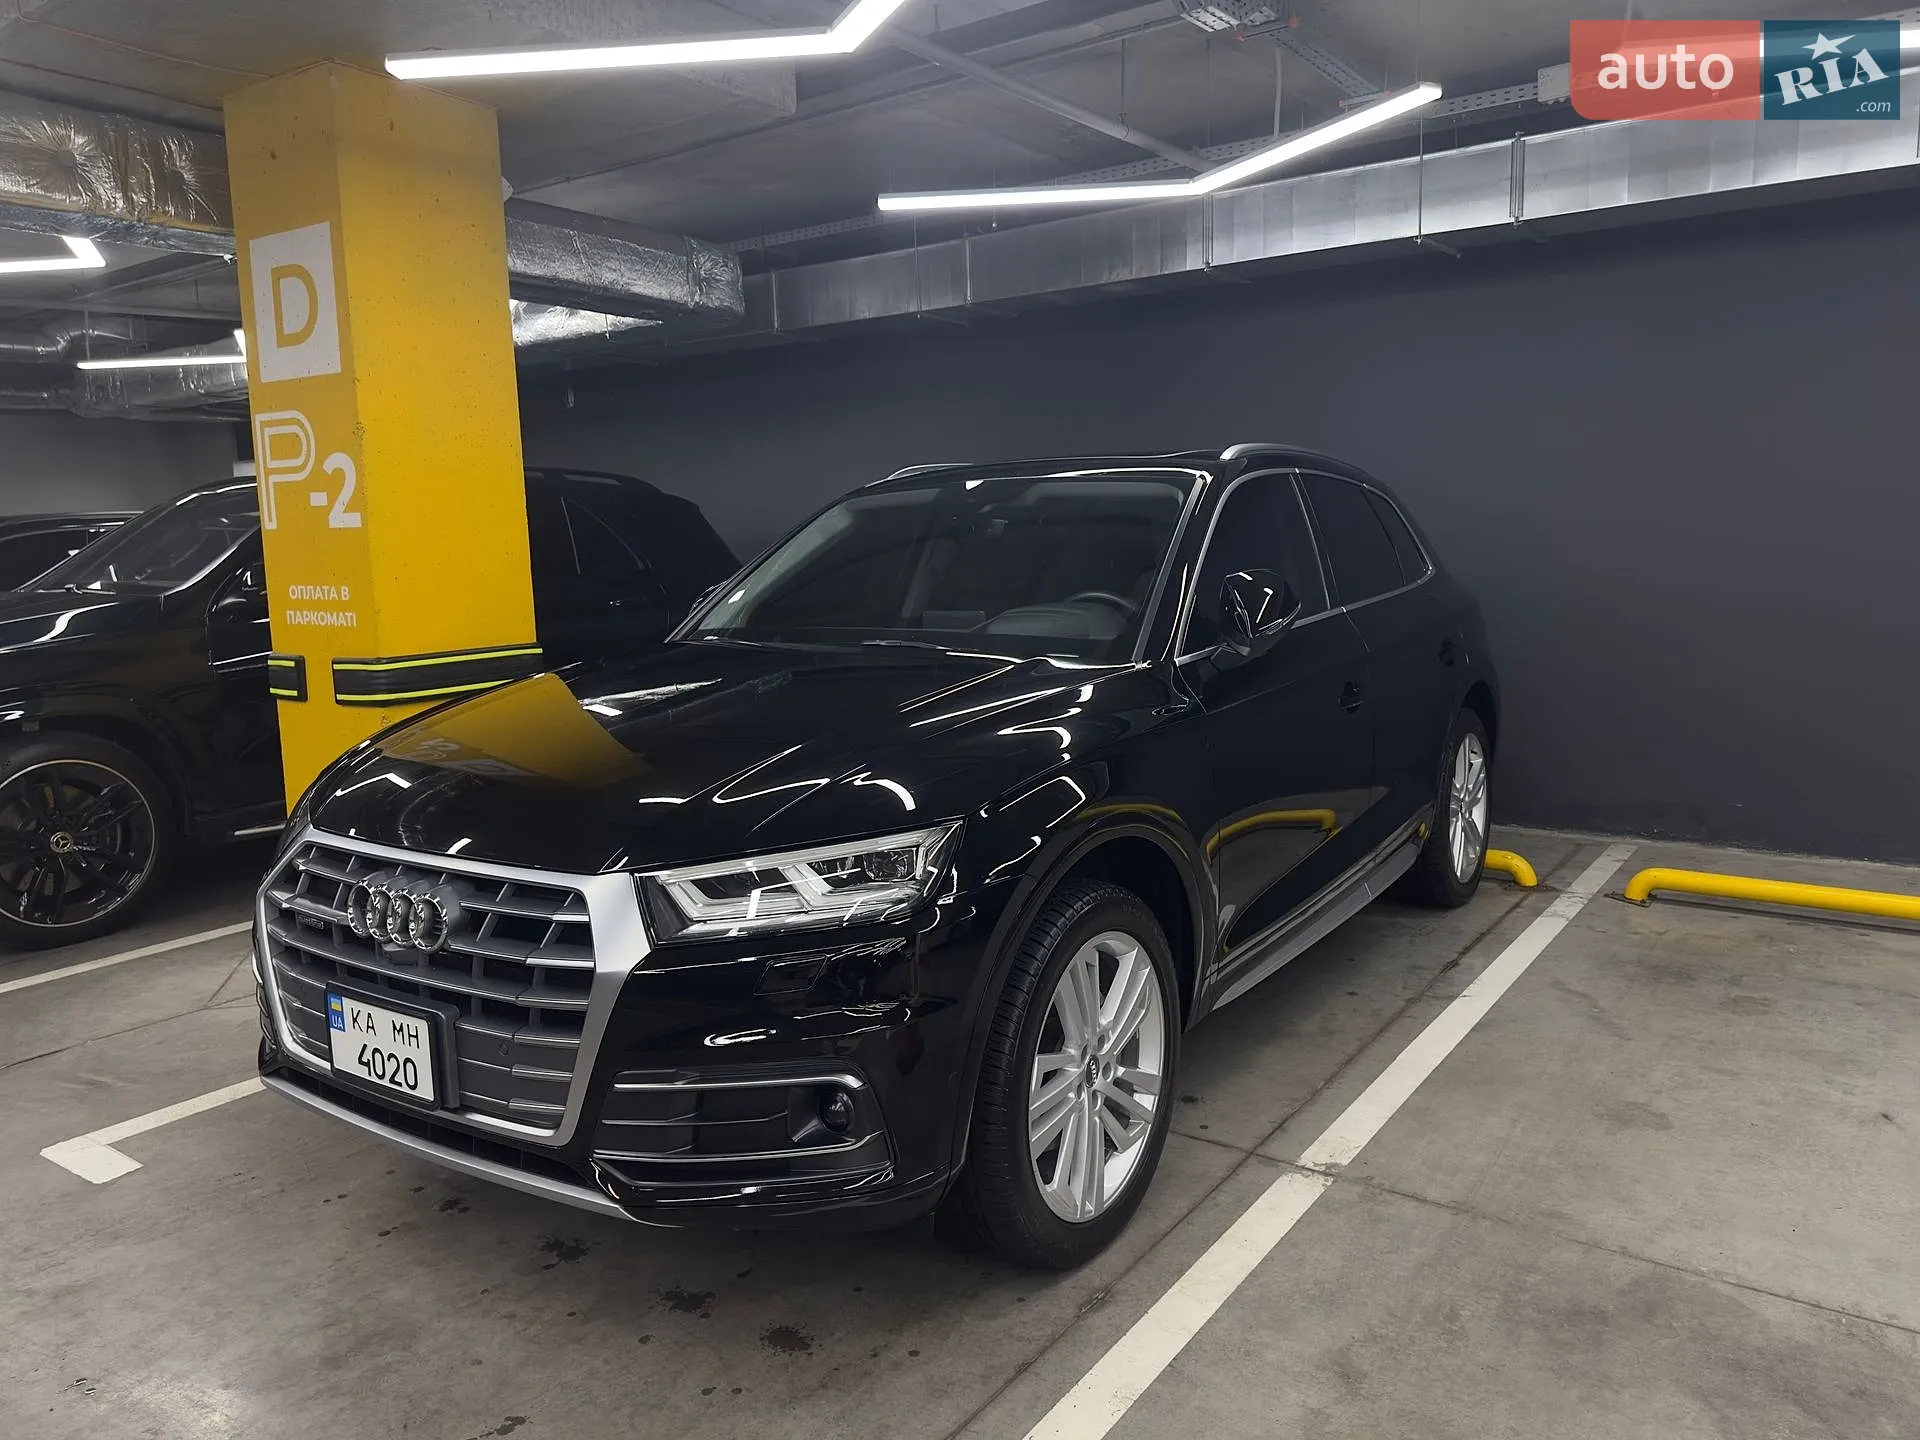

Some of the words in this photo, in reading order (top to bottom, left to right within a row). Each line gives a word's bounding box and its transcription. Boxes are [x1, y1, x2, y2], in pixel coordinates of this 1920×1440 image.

[270, 263, 319, 349] D
[288, 584, 339, 601] ОПЛАТА
[341, 585, 350, 601] В
[286, 609, 357, 628] ПАРКОМАТІ
[331, 1016, 345, 1030] UA
[351, 1007, 377, 1037] KA
[391, 1019, 421, 1050] MH
[357, 1043, 419, 1091] 4020
